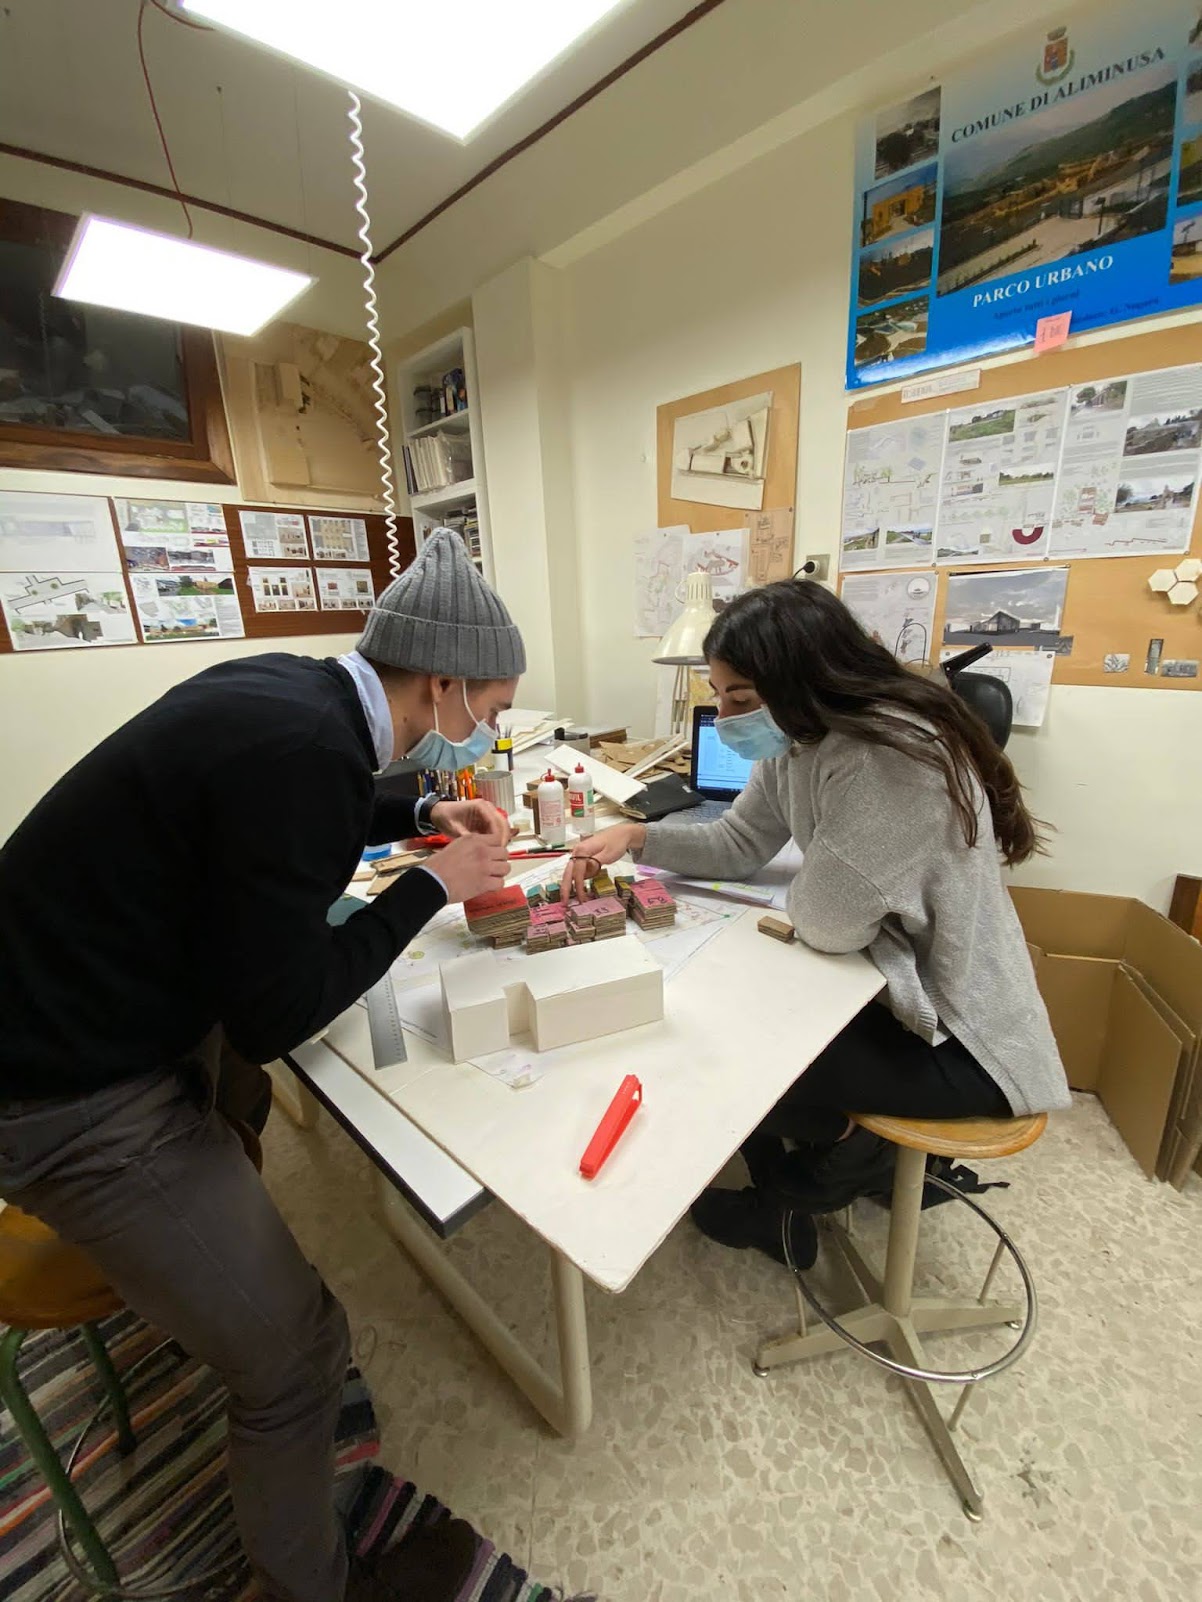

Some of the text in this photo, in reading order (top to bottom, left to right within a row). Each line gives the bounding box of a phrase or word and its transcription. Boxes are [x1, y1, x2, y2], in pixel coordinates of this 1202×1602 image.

[951, 46, 1165, 143] COMUNE DI ALIMINUSA
[973, 254, 1114, 308] PARCO URBANO
